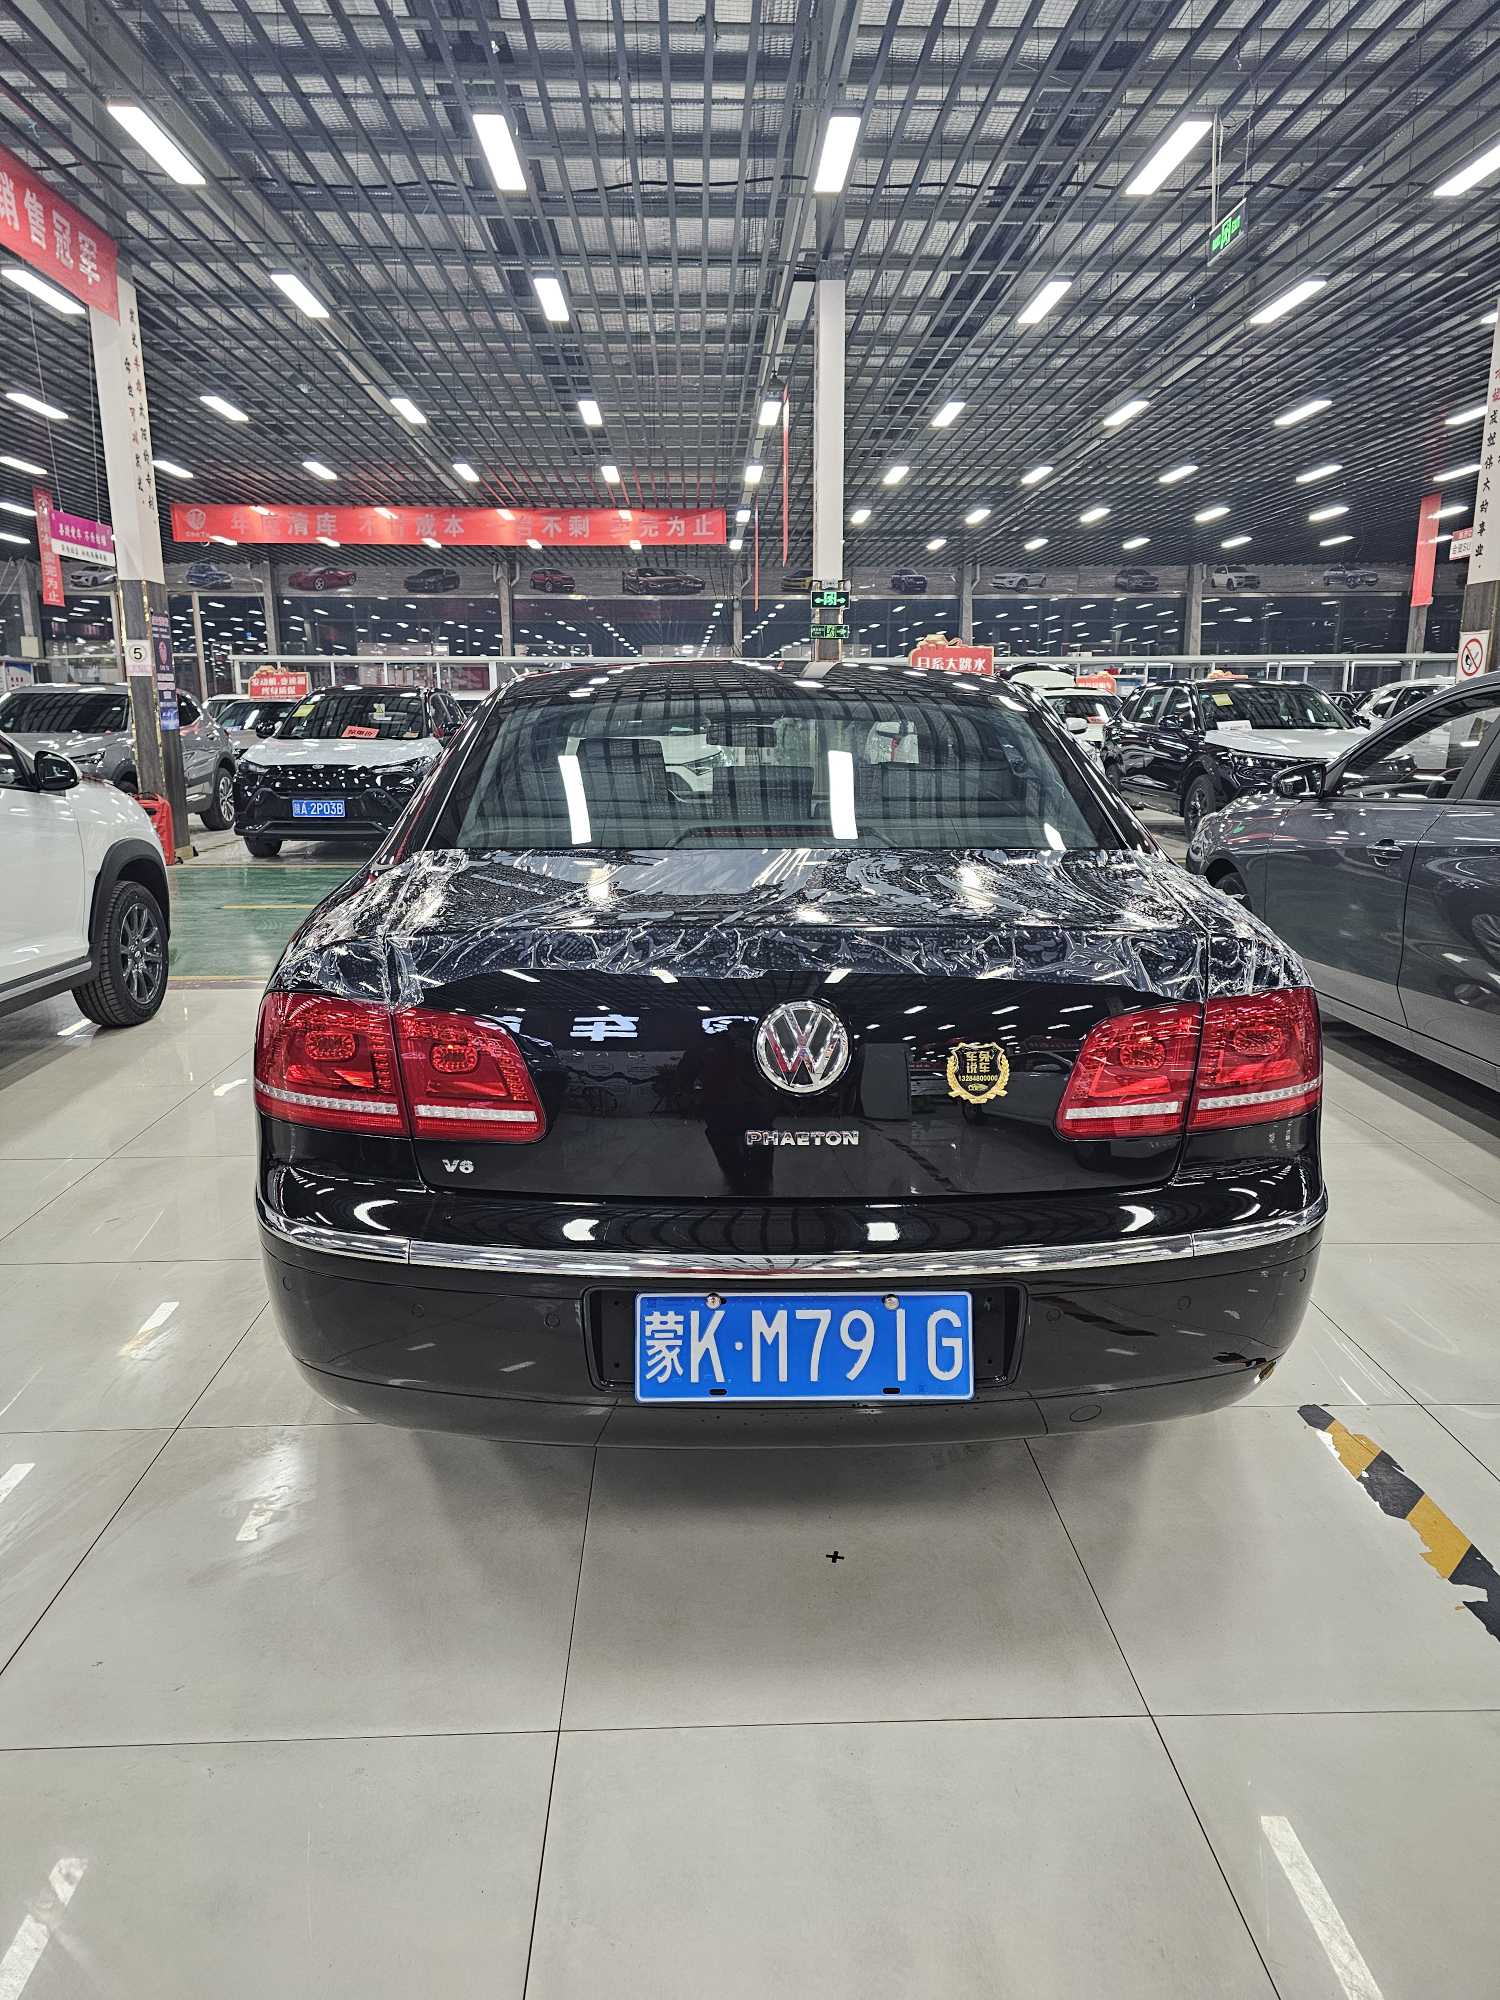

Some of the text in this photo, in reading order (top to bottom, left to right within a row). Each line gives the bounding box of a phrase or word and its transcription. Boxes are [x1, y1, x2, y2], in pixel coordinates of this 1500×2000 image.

[0, 171, 101, 286] 销售冠军
[493, 514, 590, 538] 台不剩
[133, 647, 143, 660] 5
[917, 656, 987, 672] 日系大跳水
[745, 1130, 859, 1146] PHAETON
[442, 1159, 475, 1174] V6
[644, 1308, 964, 1384] 蒙K·M791G
